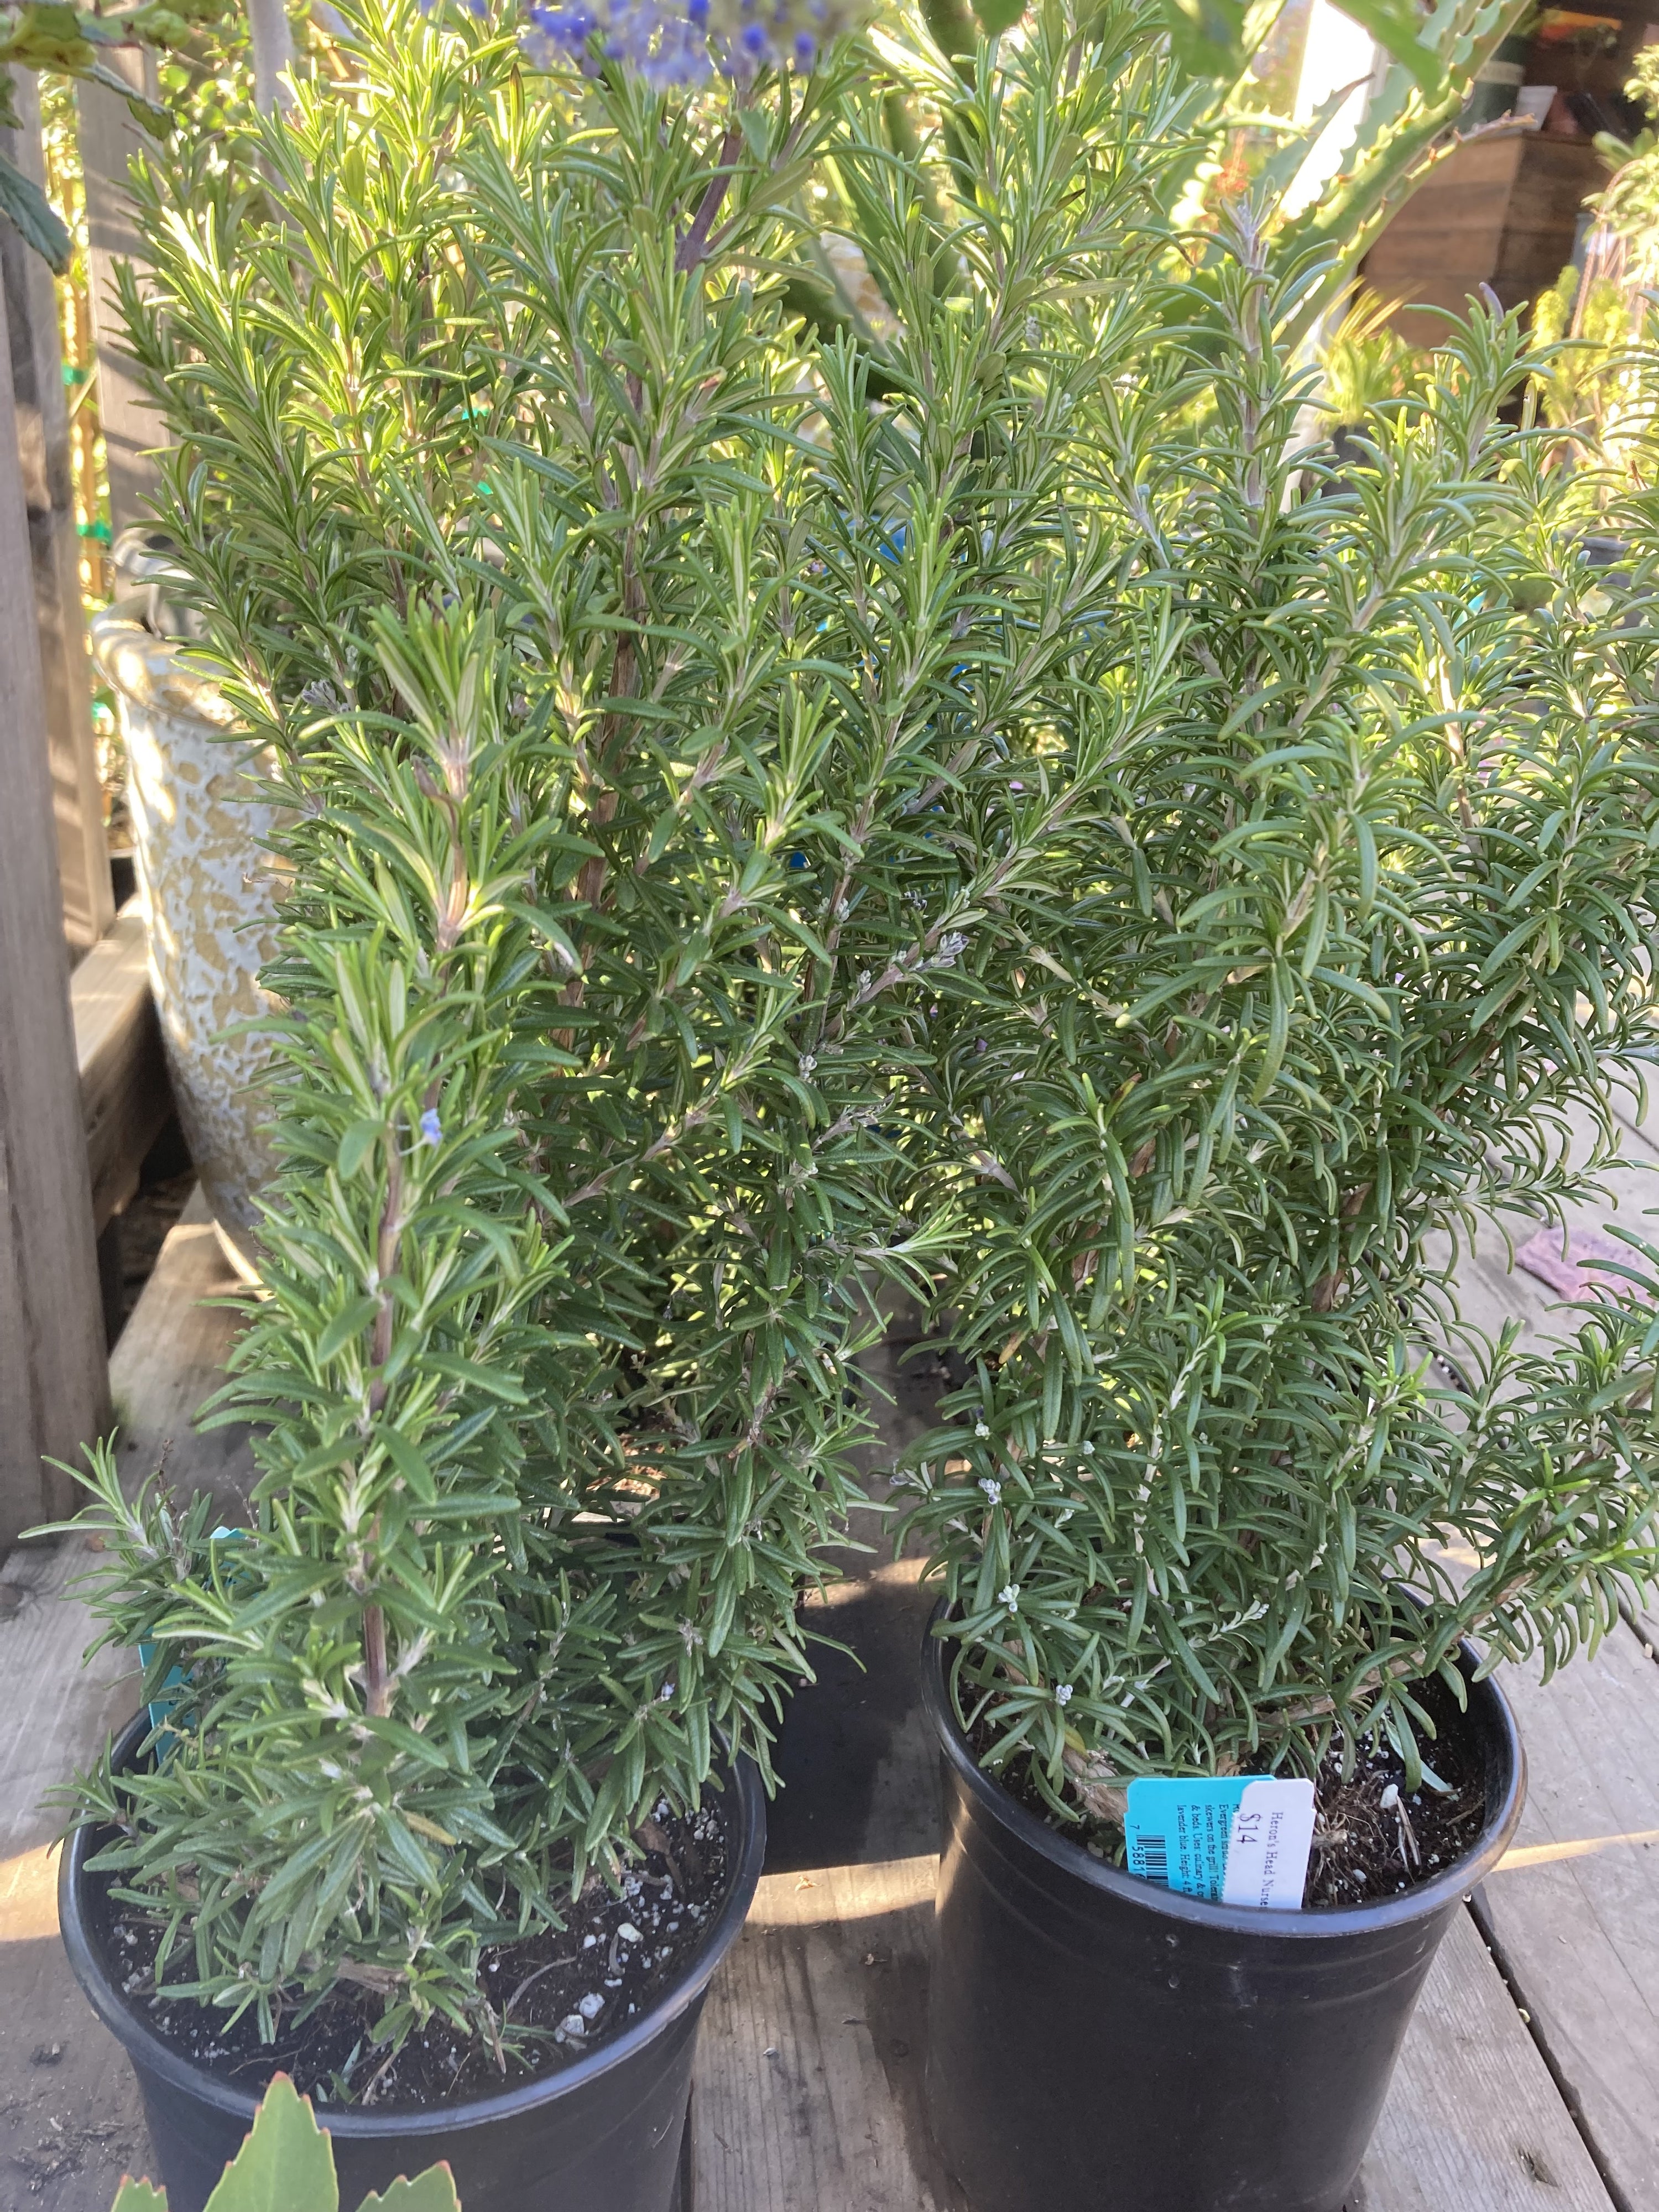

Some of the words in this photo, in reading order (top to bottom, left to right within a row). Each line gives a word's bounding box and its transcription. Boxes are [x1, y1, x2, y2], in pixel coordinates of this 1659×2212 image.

[1177, 1805, 1186, 1833] lavender
[1192, 1813, 1202, 1831] beds.
[1205, 1804, 1215, 1832] skewers
[1218, 1804, 1229, 1839] Evergreen
[1237, 1813, 1264, 1844] $14
[1267, 1812, 1284, 1848] Heron's
[1179, 1835, 1189, 1852] blue.
[1207, 1834, 1215, 1843] on
[1208, 1844, 1217, 1855] the
[1193, 1854, 1204, 1881] culinary
[1264, 1851, 1278, 1875] Head
[1260, 1879, 1274, 1907] Nurse
